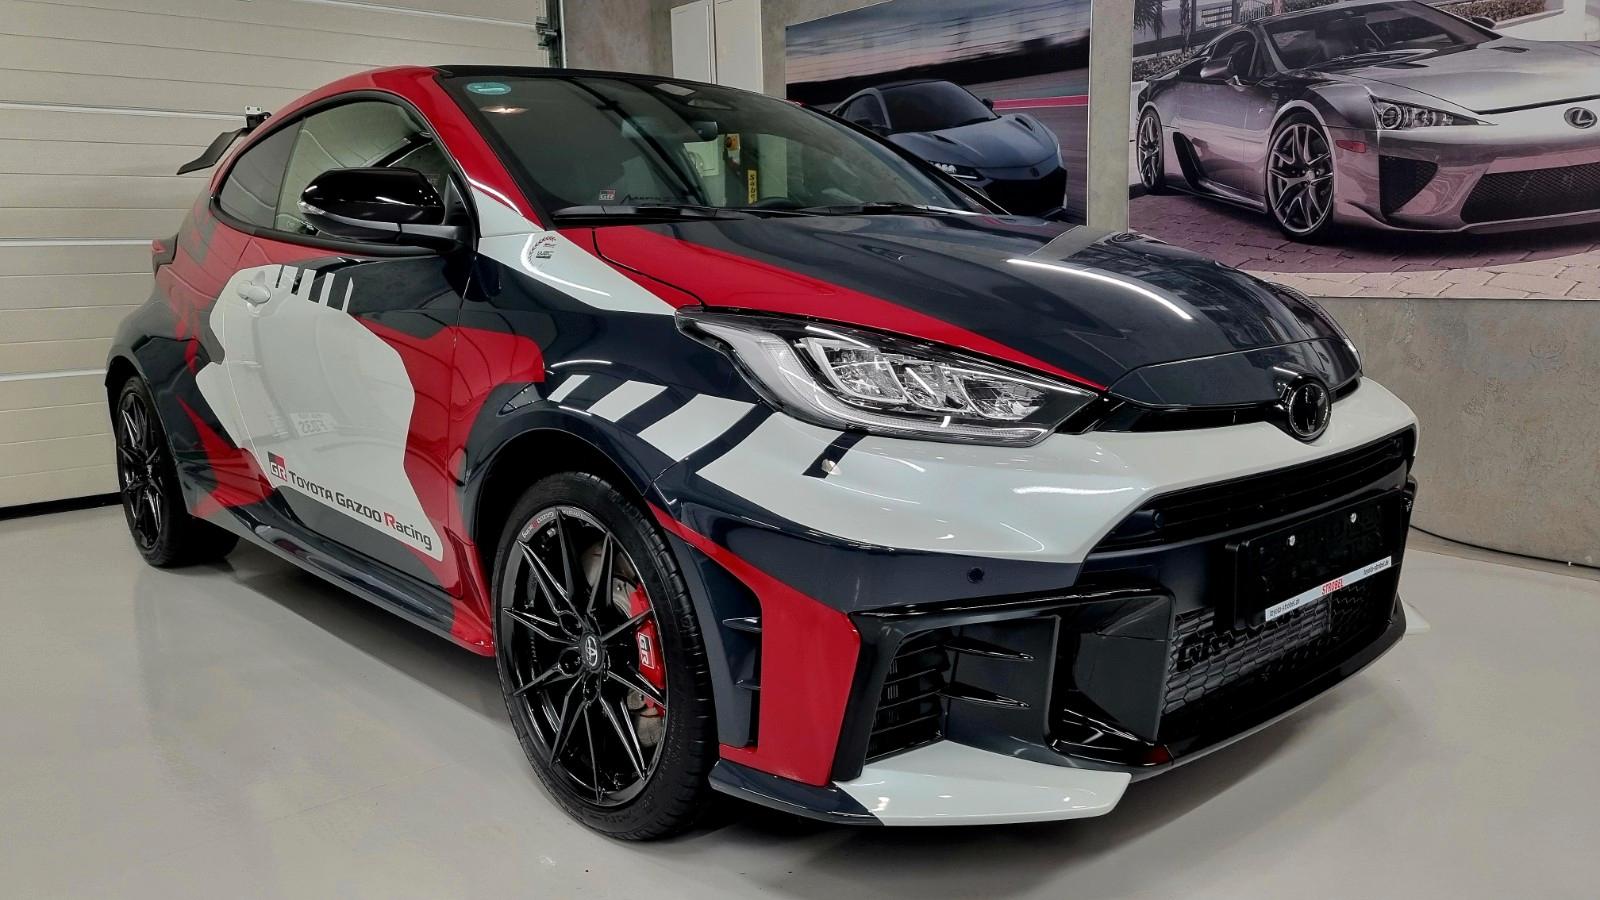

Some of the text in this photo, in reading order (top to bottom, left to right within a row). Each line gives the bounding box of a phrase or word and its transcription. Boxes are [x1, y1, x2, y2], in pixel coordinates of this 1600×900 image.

[270, 461, 433, 551] GR TOYOTA GAZOO Racing
[1322, 578, 1343, 595] STROBEL
[639, 634, 649, 665] GR
